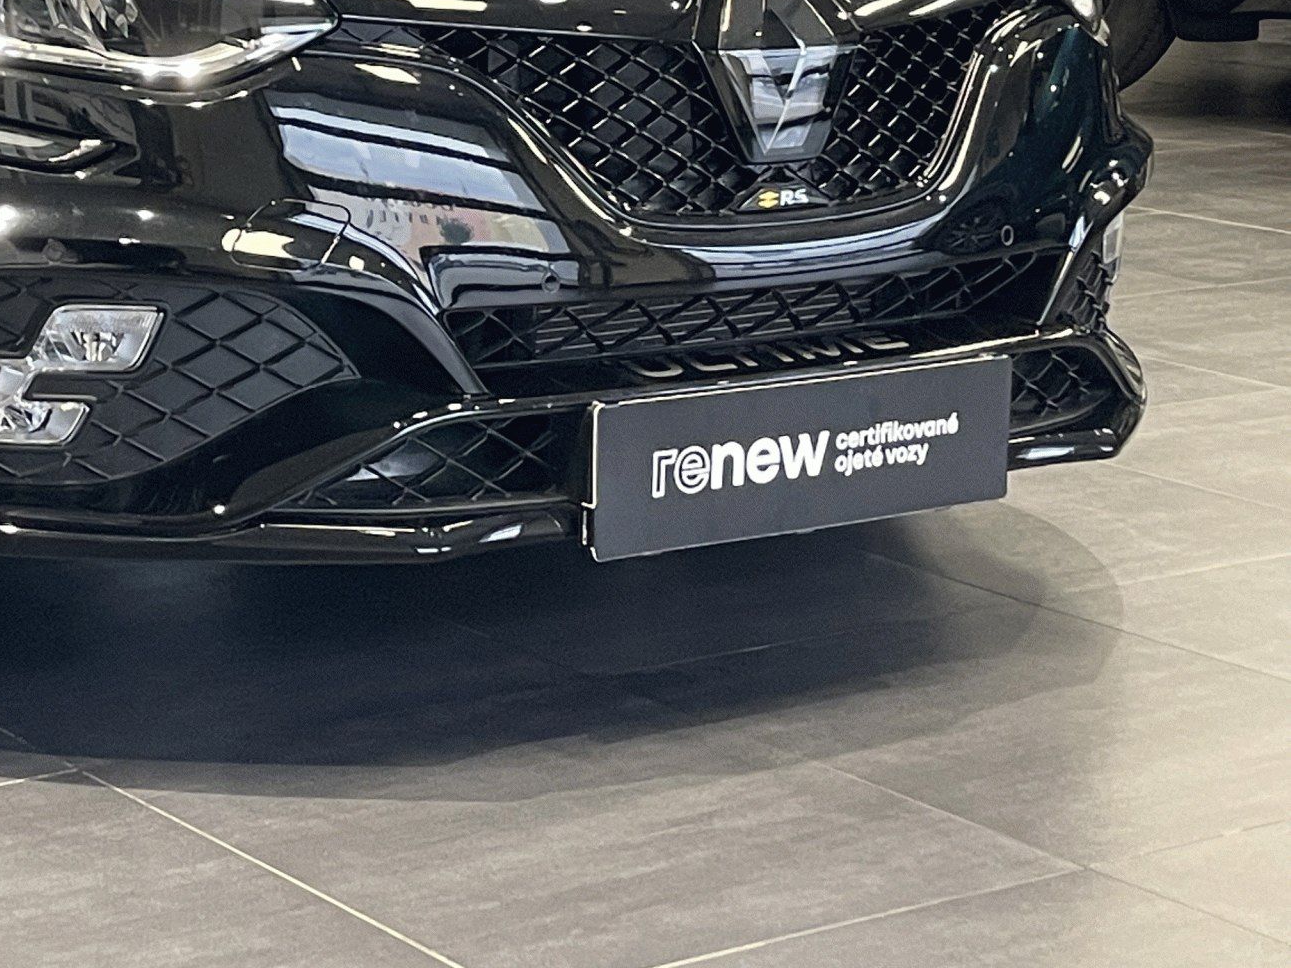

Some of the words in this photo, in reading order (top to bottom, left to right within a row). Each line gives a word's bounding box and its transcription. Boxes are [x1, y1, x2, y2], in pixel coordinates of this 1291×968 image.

[779, 188, 809, 207] RS
[835, 411, 959, 450] certifikované
[651, 429, 831, 499] renew
[834, 444, 884, 477] ojeté
[884, 442, 929, 466] vozy
